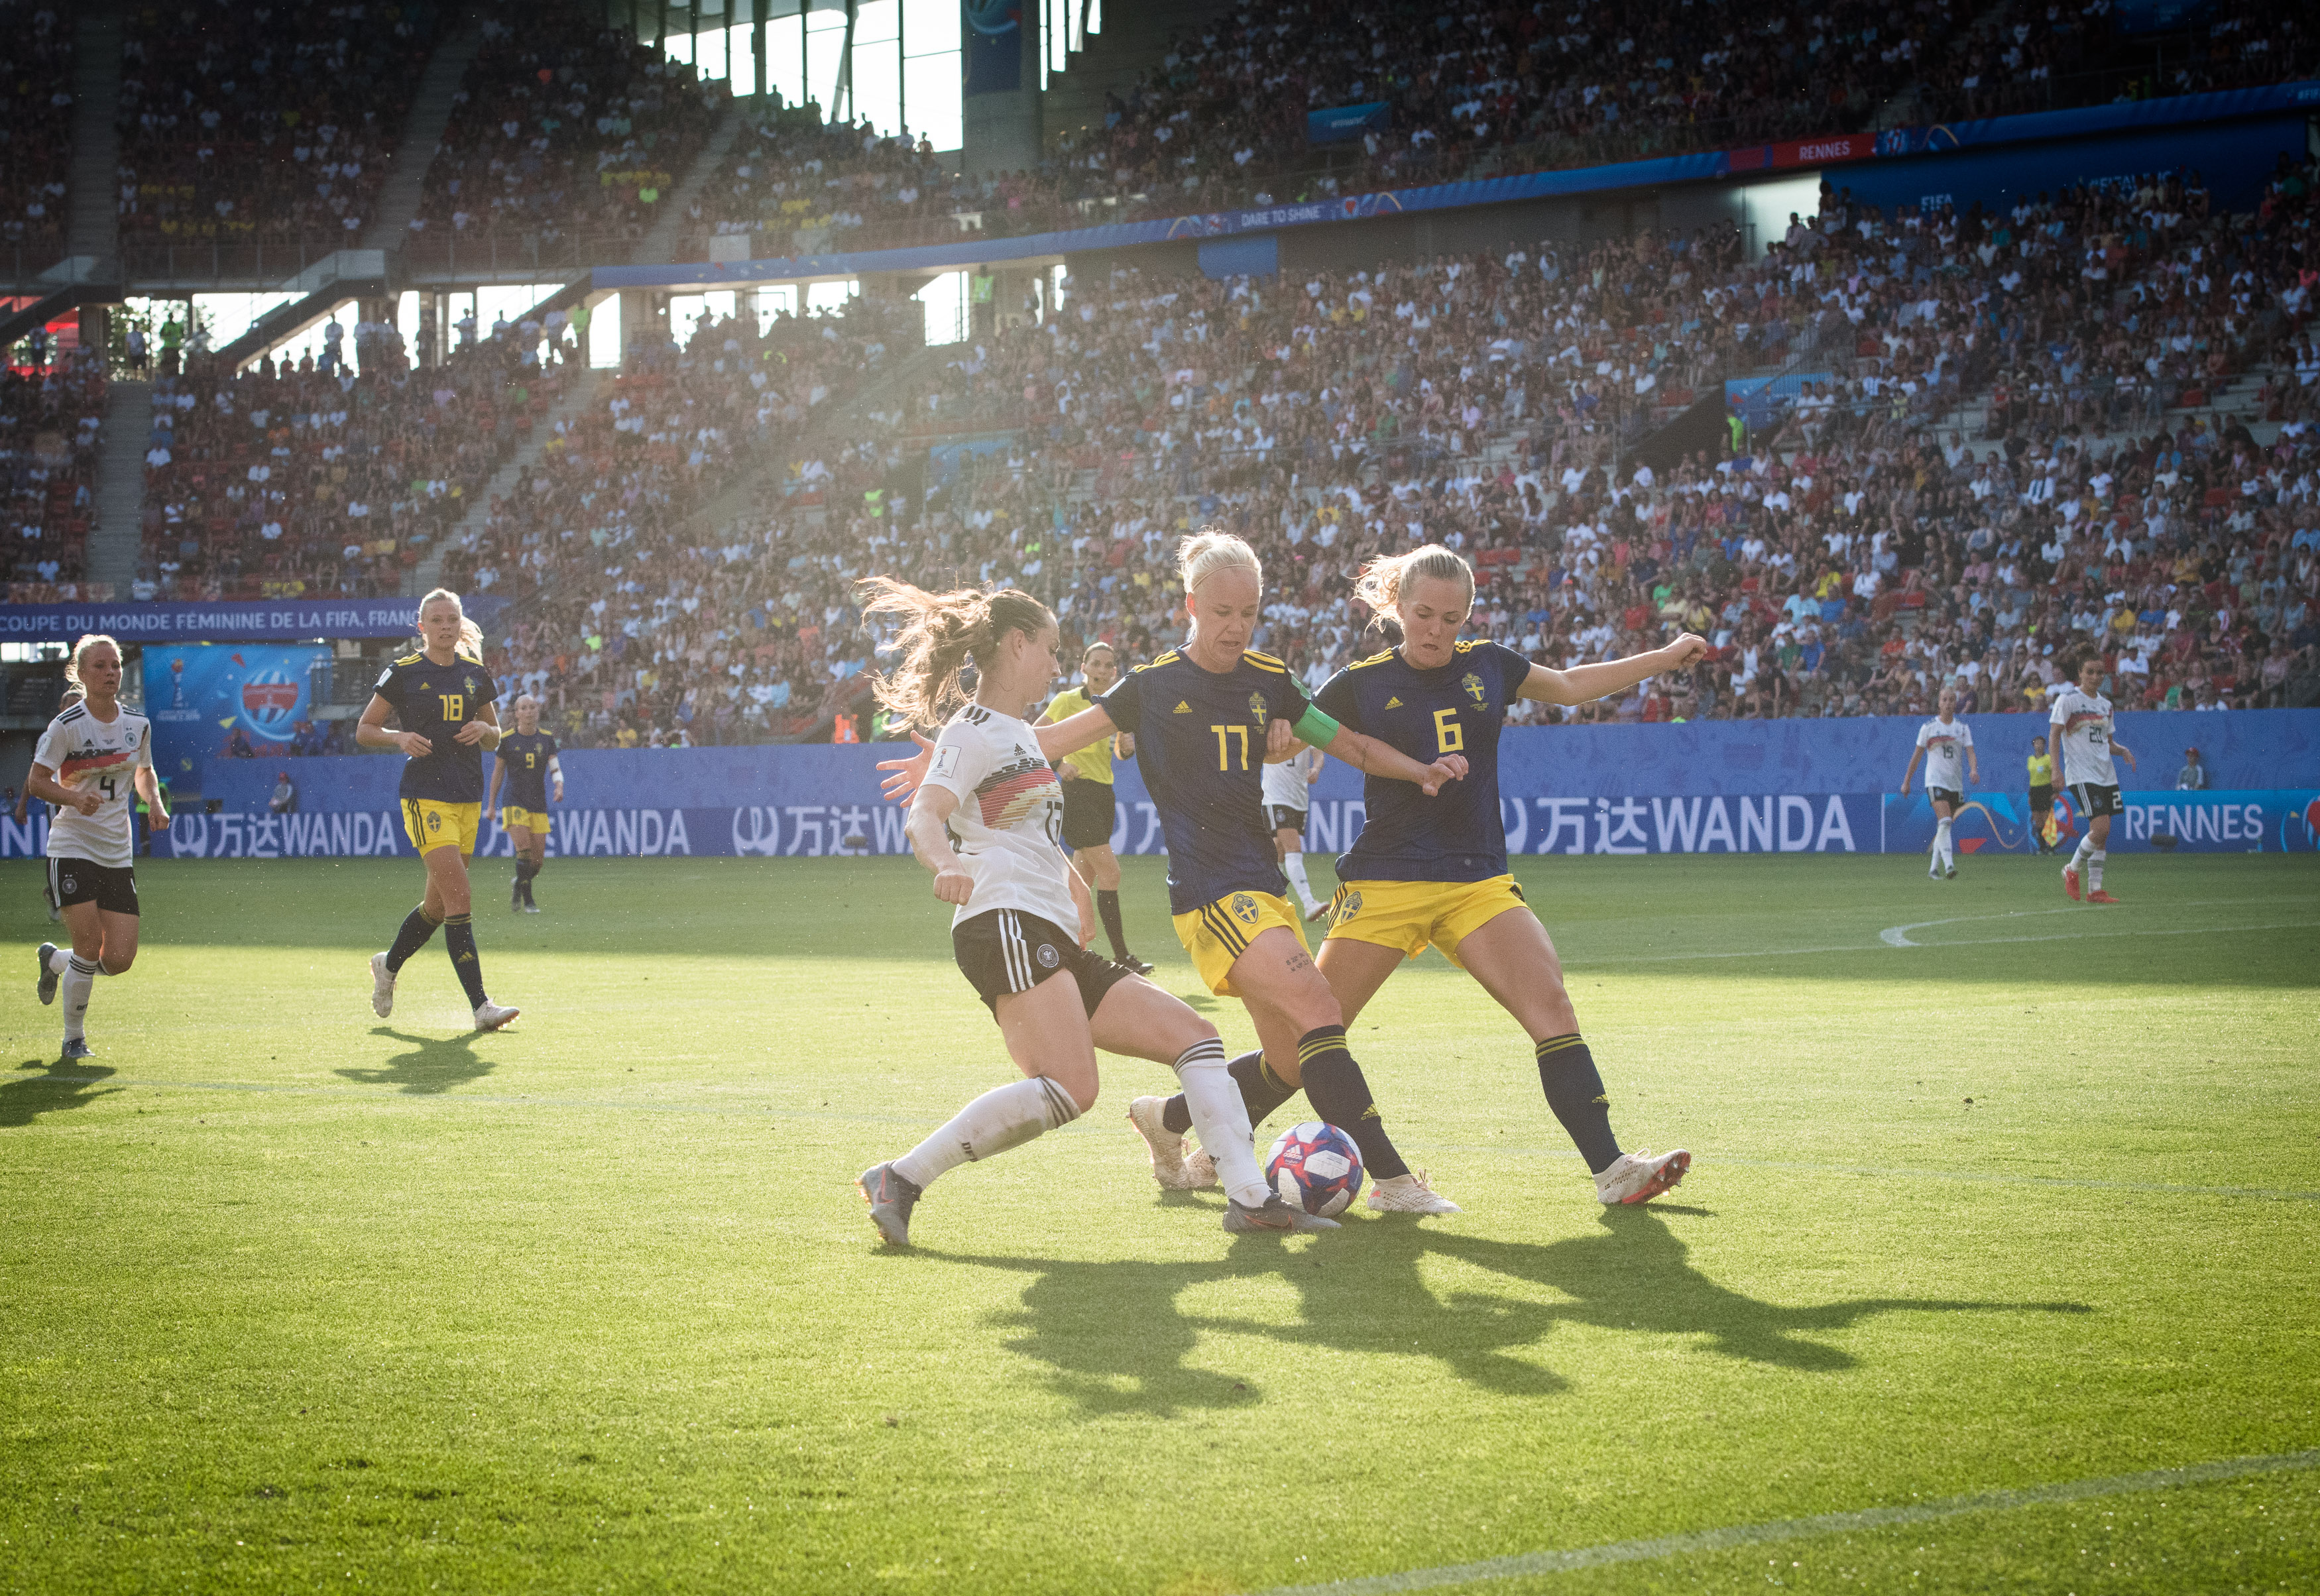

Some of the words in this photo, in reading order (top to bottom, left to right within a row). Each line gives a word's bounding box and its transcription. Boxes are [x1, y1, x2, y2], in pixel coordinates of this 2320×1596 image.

[1798, 140, 1851, 160] RENNES
[1241, 211, 1269, 227] DARE
[1272, 209, 1287, 224] TO
[1287, 206, 1320, 221] SHINE
[66, 614, 93, 630] DU
[99, 613, 170, 630] MONDE
[176, 610, 265, 630] FÉMININE
[270, 611, 294, 629] DE
[298, 611, 321, 628] LA
[368, 609, 420, 627] FRANC
[438, 694, 463, 721] 18
[1385, 702, 1404, 711] adidas
[1210, 724, 1249, 771] 17
[1433, 707, 1464, 754] 6
[526, 752, 535, 769] 9
[100, 775, 115, 801] 4
[213, 812, 279, 858] 万达
[280, 811, 398, 856] WANDA
[557, 809, 691, 856] WANDA
[785, 805, 870, 857] 万达
[1536, 796, 1648, 855] 万达
[1651, 795, 1856, 853] WANDA
[2125, 804, 2264, 843] RENNES
[1283, 1152, 1303, 1161] adidas
